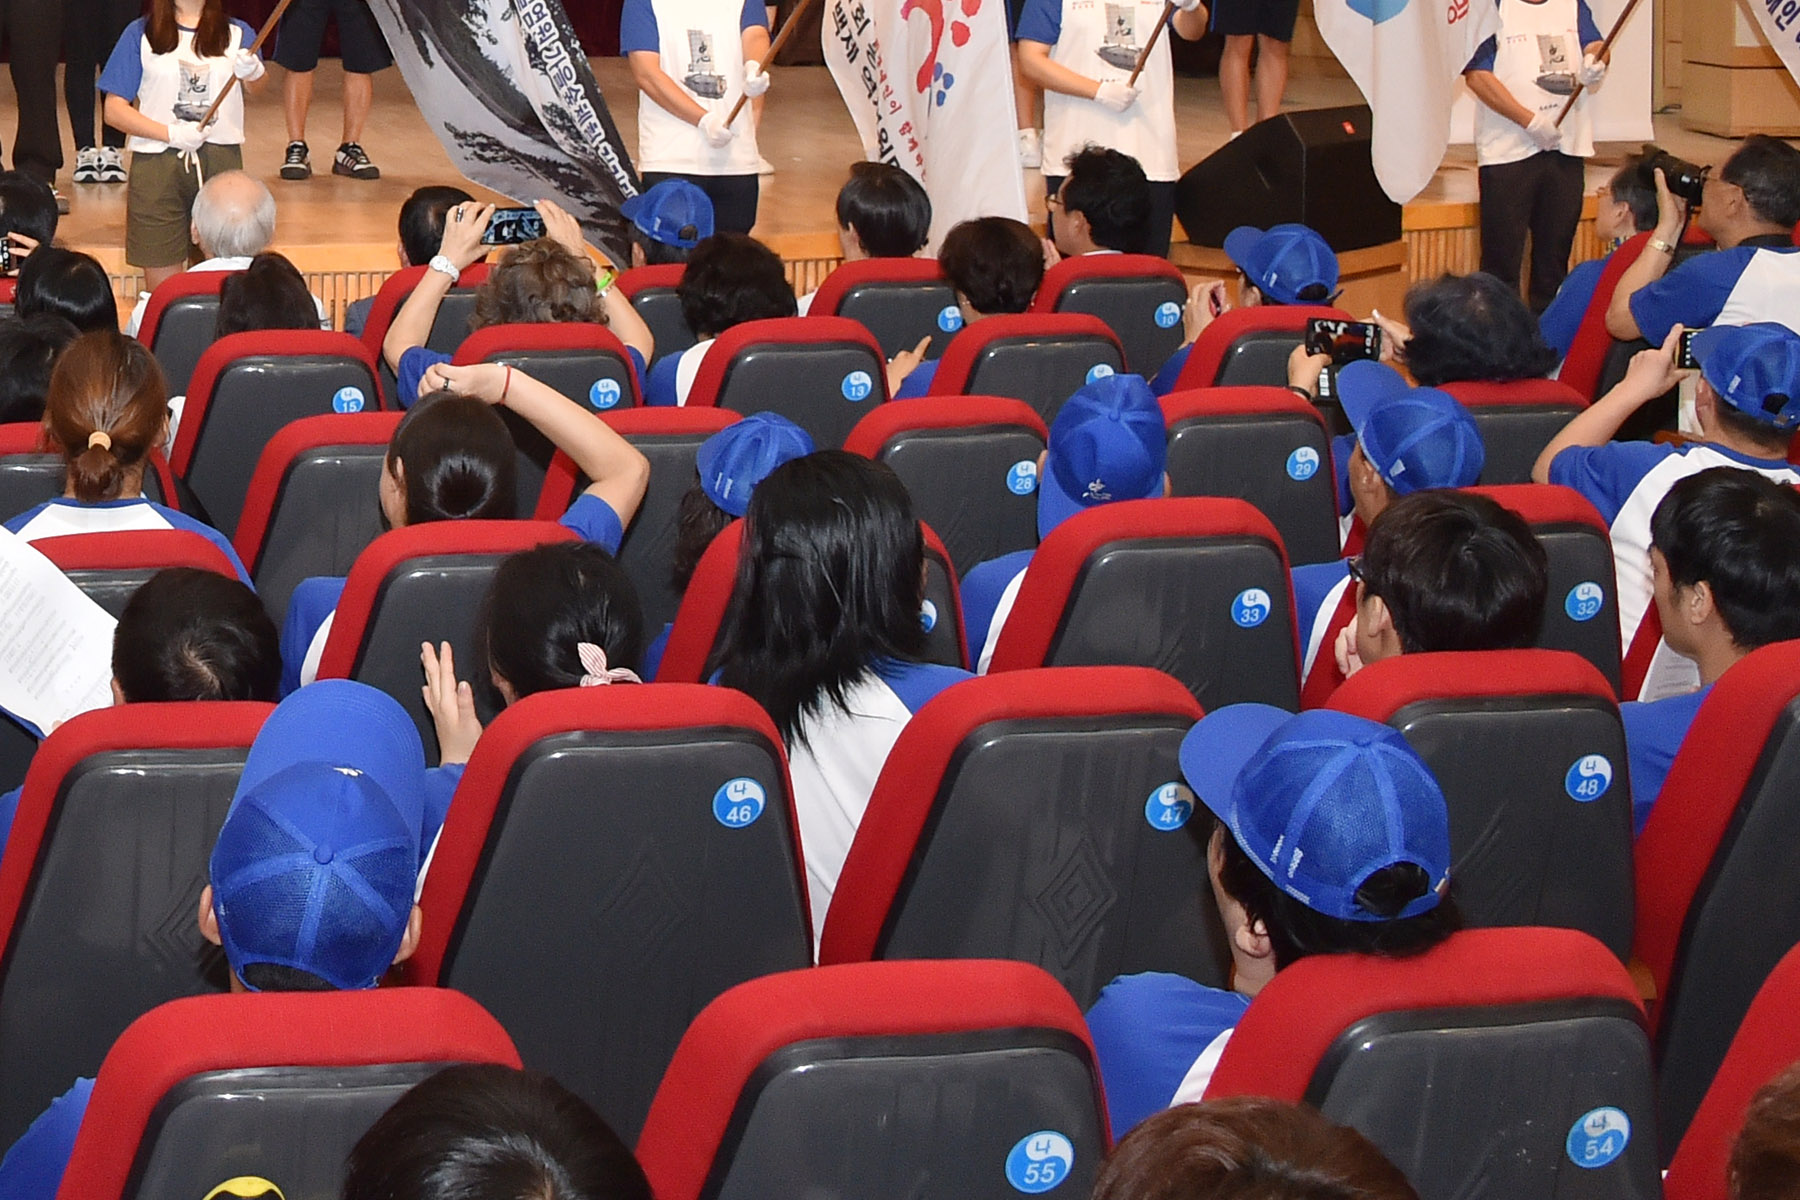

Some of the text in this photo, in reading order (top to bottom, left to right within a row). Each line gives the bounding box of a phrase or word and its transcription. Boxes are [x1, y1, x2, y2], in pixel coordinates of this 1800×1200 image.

[831, 0, 860, 65] 백제
[1162, 316, 1174, 325] 10
[850, 386, 864, 395] 13
[599, 394, 613, 403] 14
[342, 402, 357, 411] 15
[1296, 464, 1311, 475] 29
[1016, 477, 1031, 489] 28
[1578, 601, 1594, 614] 32
[1242, 609, 1259, 622] 33
[1577, 780, 1599, 795] 48
[726, 805, 751, 822] 46
[1160, 806, 1183, 822] 47
[1585, 1136, 1613, 1158] 54
[1024, 1164, 1056, 1183] 55
